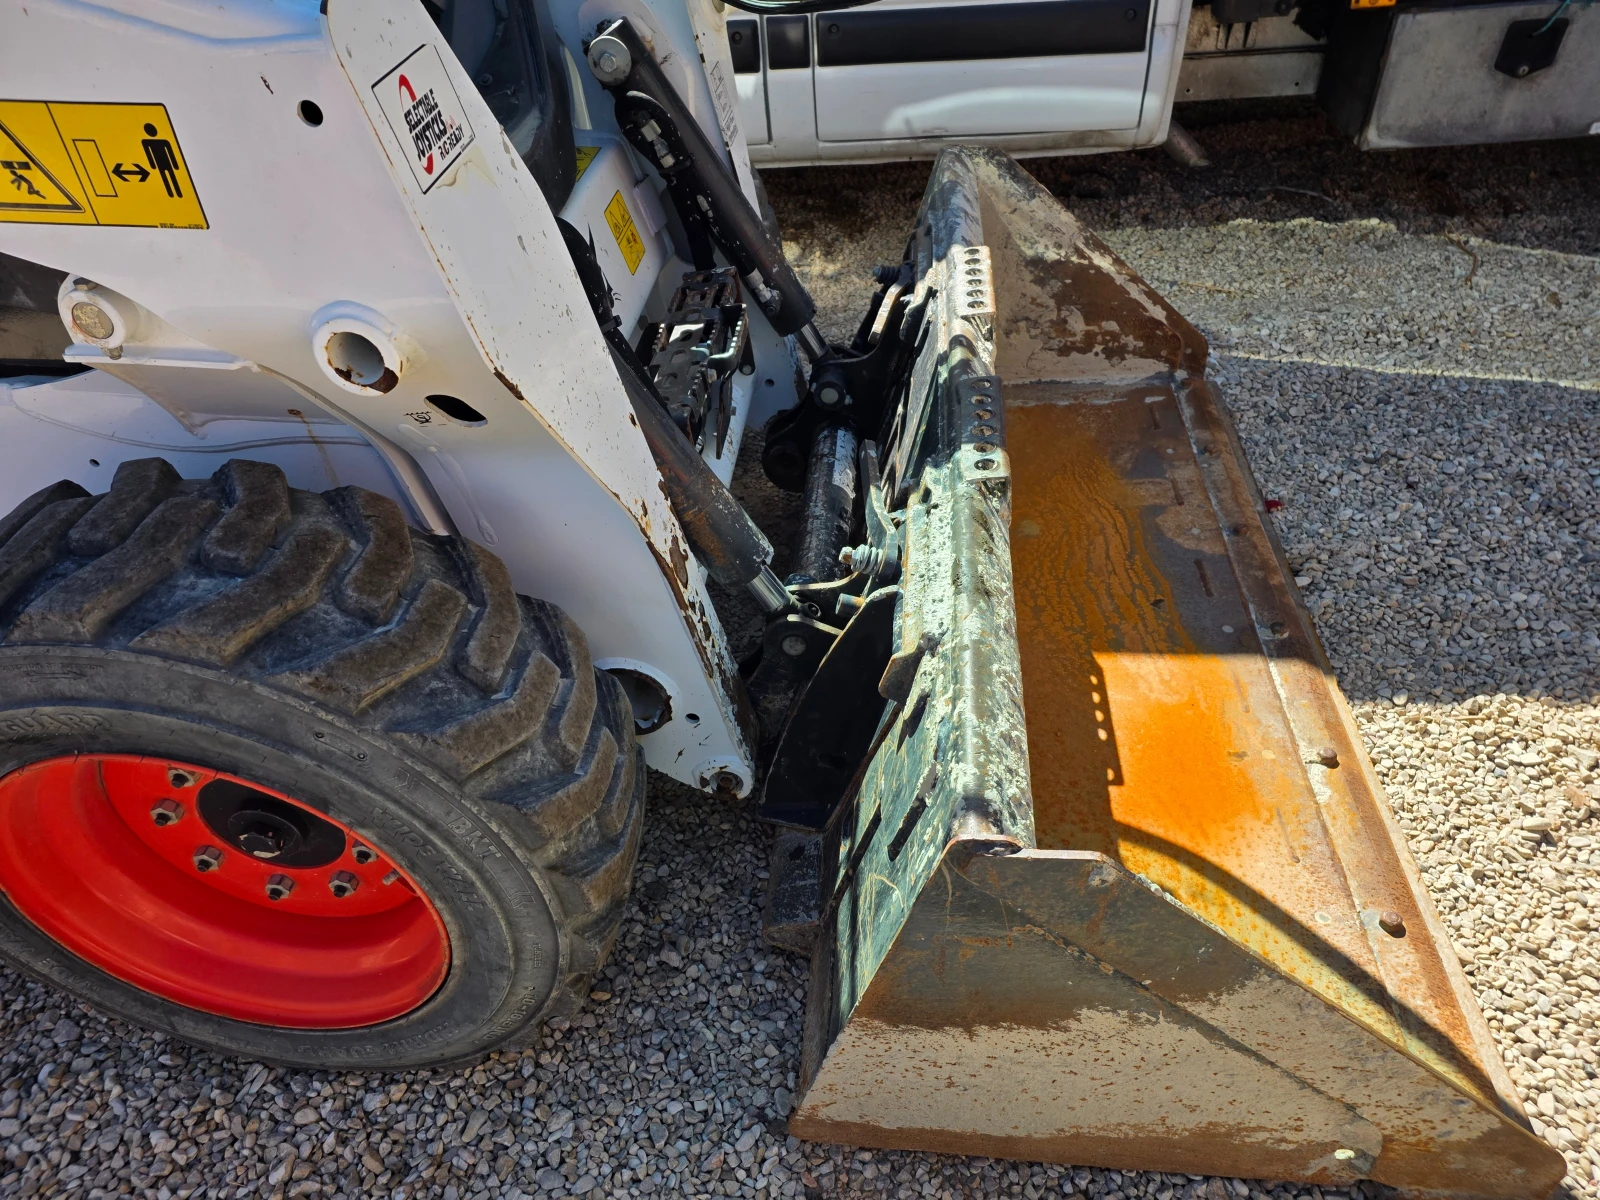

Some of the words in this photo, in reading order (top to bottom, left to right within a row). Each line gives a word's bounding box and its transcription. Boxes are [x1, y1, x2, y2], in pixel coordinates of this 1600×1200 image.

[403, 87, 439, 135] SELECTABLE
[411, 109, 447, 162] JOYSTICKS
[447, 123, 465, 151] READY
[371, 806, 437, 859] WIDE
[448, 816, 502, 863] BKT
